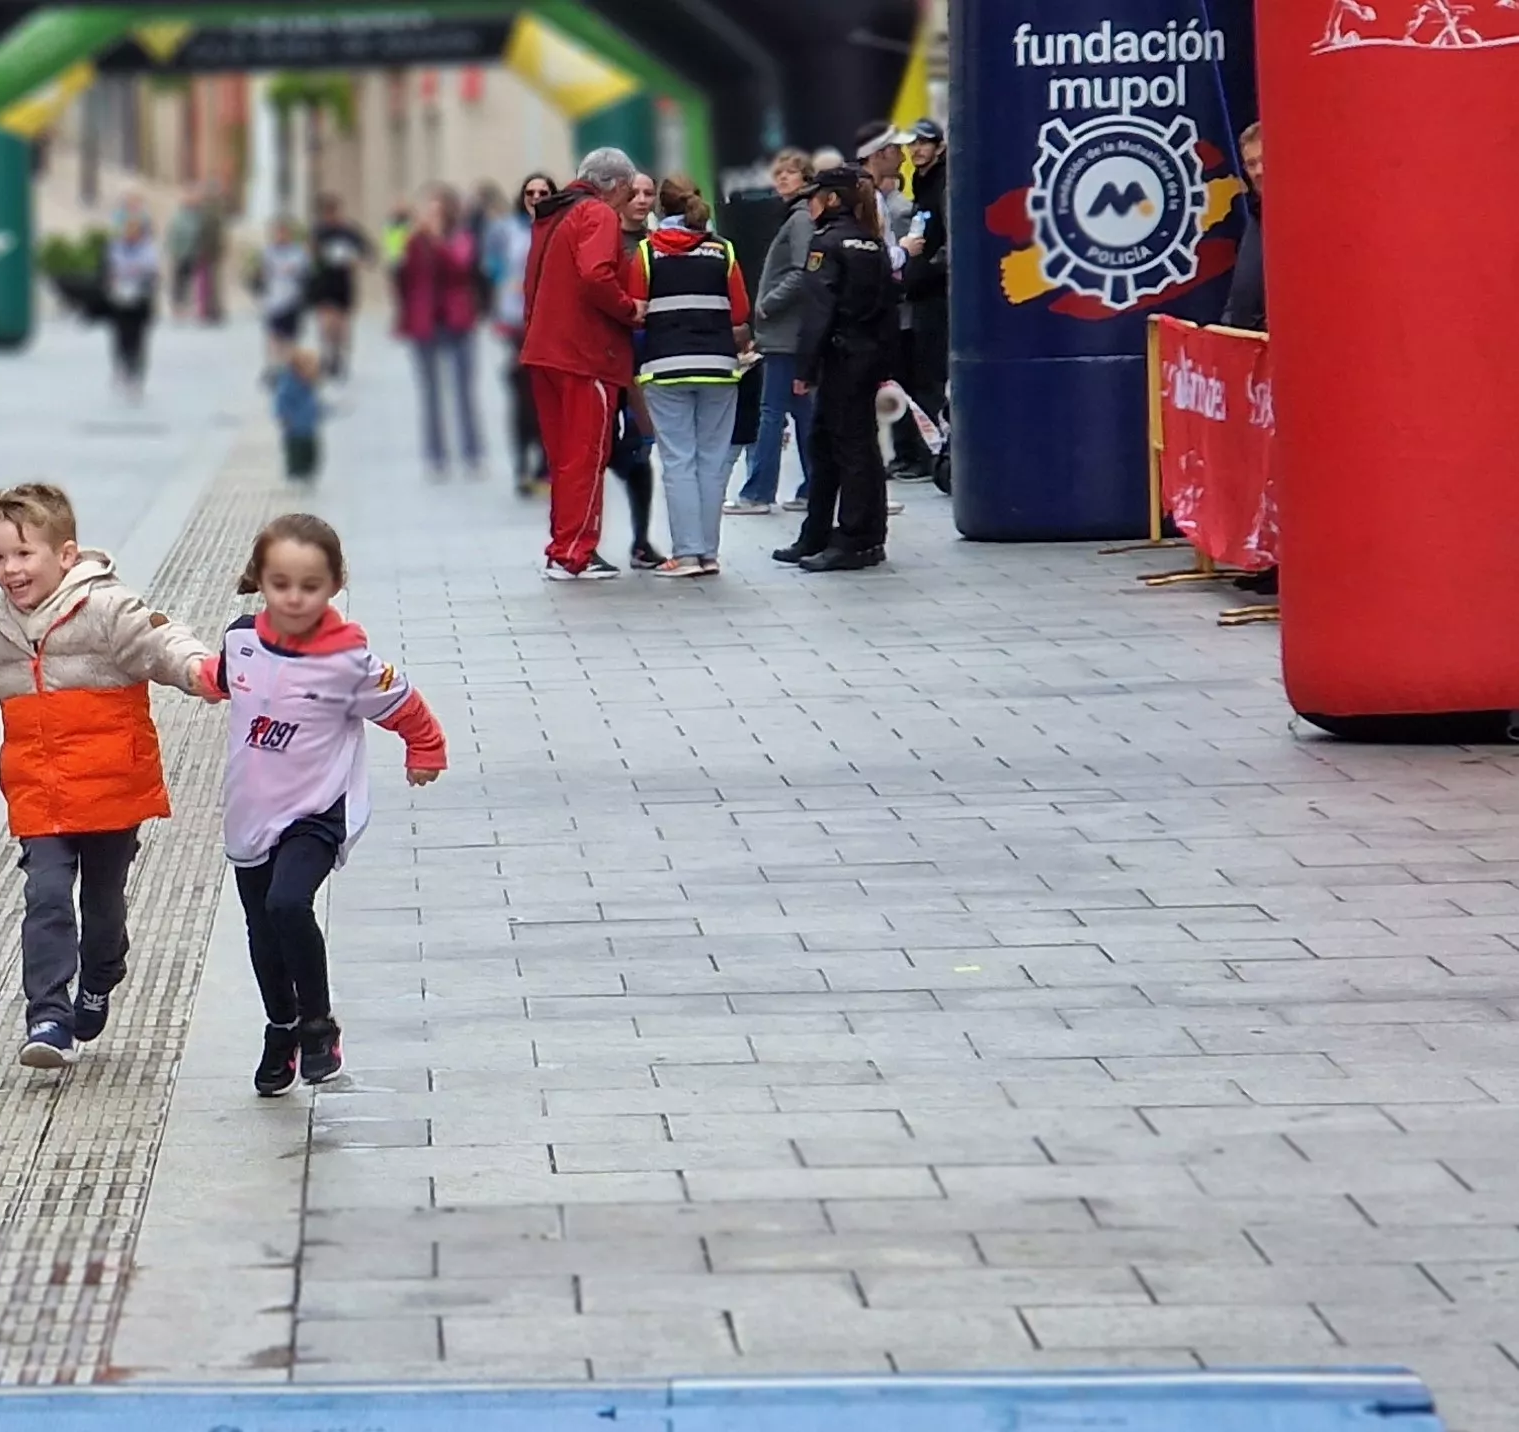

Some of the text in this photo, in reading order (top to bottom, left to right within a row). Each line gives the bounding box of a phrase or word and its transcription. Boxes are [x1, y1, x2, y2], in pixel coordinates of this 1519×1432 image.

[1014, 18, 1225, 66] fundación
[1049, 65, 1186, 116] mupol
[1058, 157, 1087, 214] Fundación
[1086, 147, 1101, 160] de
[1103, 141, 1115, 152] la
[1118, 139, 1175, 180] Mutualidad
[1087, 246, 1153, 265] POLICÍA
